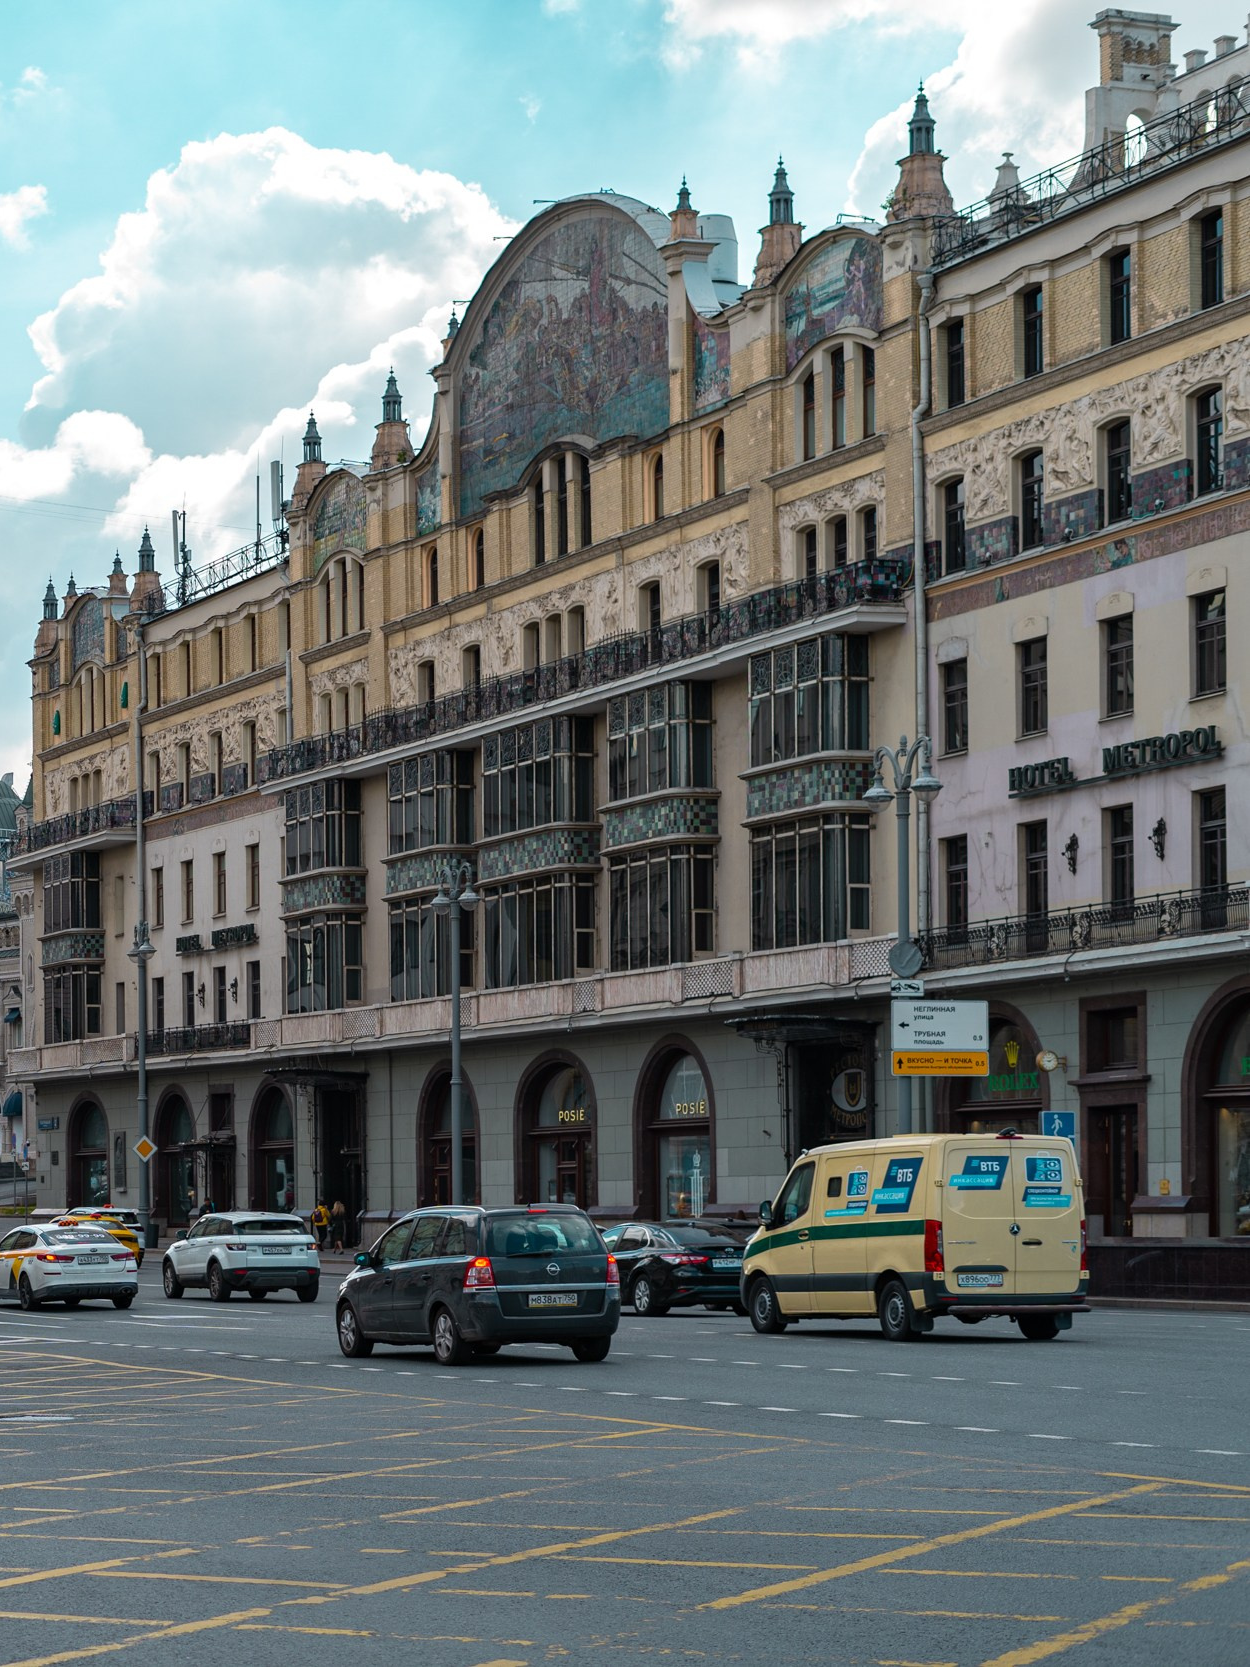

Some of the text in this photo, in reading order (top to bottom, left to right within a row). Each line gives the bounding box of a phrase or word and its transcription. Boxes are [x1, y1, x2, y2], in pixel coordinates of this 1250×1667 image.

[1008, 724, 1222, 791] HOTEL METROPOL
[176, 923, 257, 952] HOTEL METROPOL
[988, 1071, 1039, 1092] ROLEX
[980, 1161, 1000, 1172] ВТБ
[896, 1168, 913, 1183] ВТБ
[960, 1275, 989, 1284] Х896ОО
[531, 1295, 563, 1305] М838АТ
